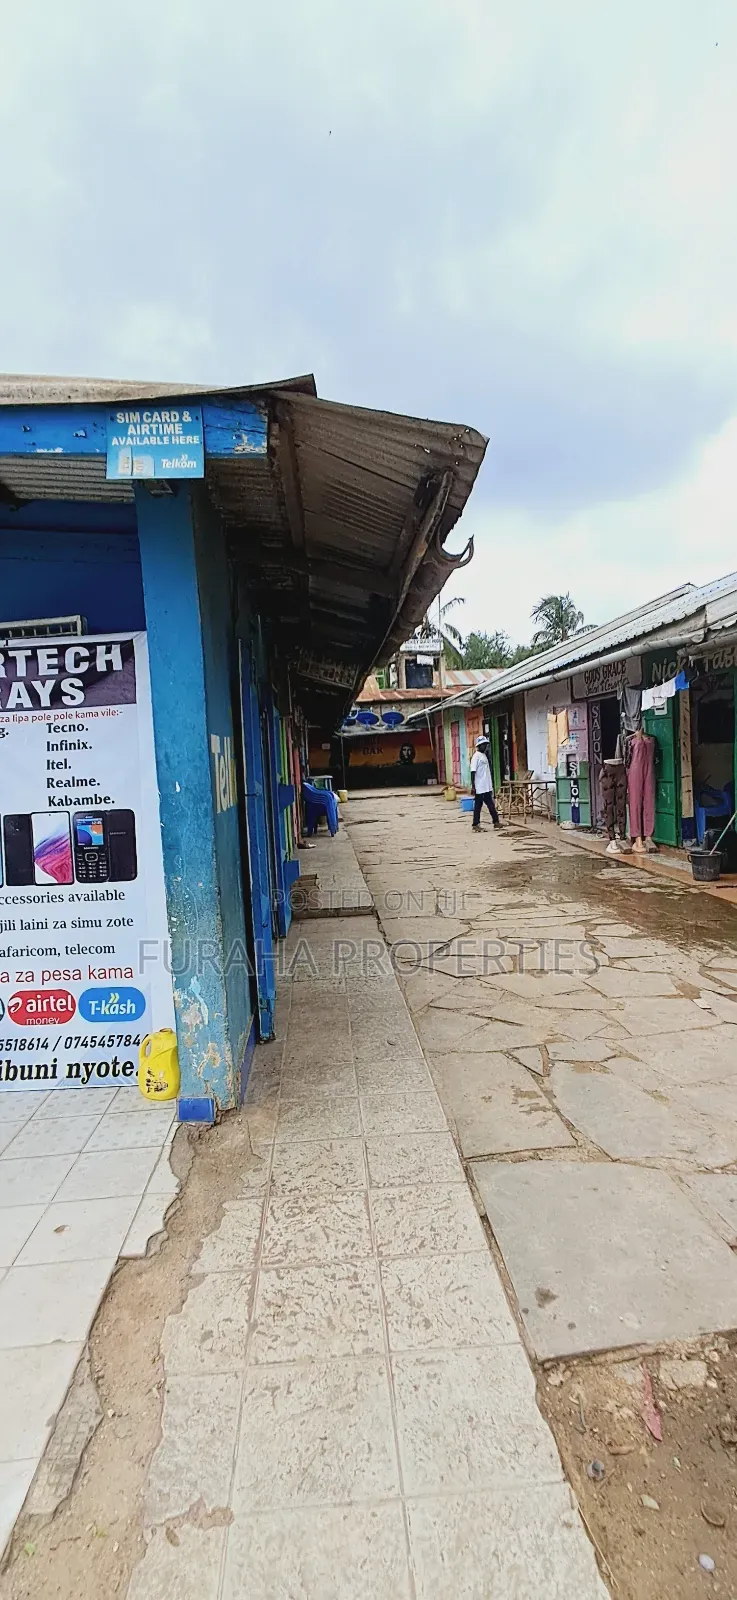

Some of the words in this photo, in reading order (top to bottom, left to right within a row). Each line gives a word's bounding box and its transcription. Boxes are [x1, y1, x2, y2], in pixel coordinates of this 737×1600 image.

[116, 411, 140, 423] SIM
[143, 411, 180, 423] CARD
[182, 410, 192, 422] &
[127, 423, 183, 435] AIRTIME
[111, 435, 169, 446] AVAILABLE
[171, 435, 200, 445] HERE
[161, 458, 196, 469] Telkom
[0, 644, 123, 678] TECH
[0, 678, 85, 709] AYS
[12, 713, 29, 723] lipa
[31, 712, 51, 722] pole
[53, 711, 73, 721] pole
[75, 710, 98, 719] kama
[101, 708, 123, 717] vile:-
[46, 723, 89, 733] Tecno.
[591, 705, 603, 765] SALON
[46, 739, 93, 752] Infinix.
[46, 758, 72, 770] Itel.
[46, 776, 100, 788] Realme.
[569, 761, 579, 808] SALON
[48, 794, 115, 807] Kabambe.
[68, 889, 125, 902] available
[20, 918, 48, 930] laini
[53, 921, 67, 929] za
[71, 918, 102, 928] simu
[106, 917, 134, 927] zote
[65, 944, 115, 955] telecom
[15, 971, 35, 982] za
[41, 969, 82, 985] pesa
[88, 965, 134, 980] kama
[26, 995, 74, 1013] airtel
[89, 1000, 136, 1015] T-kash
[26, 1017, 60, 1025] money
